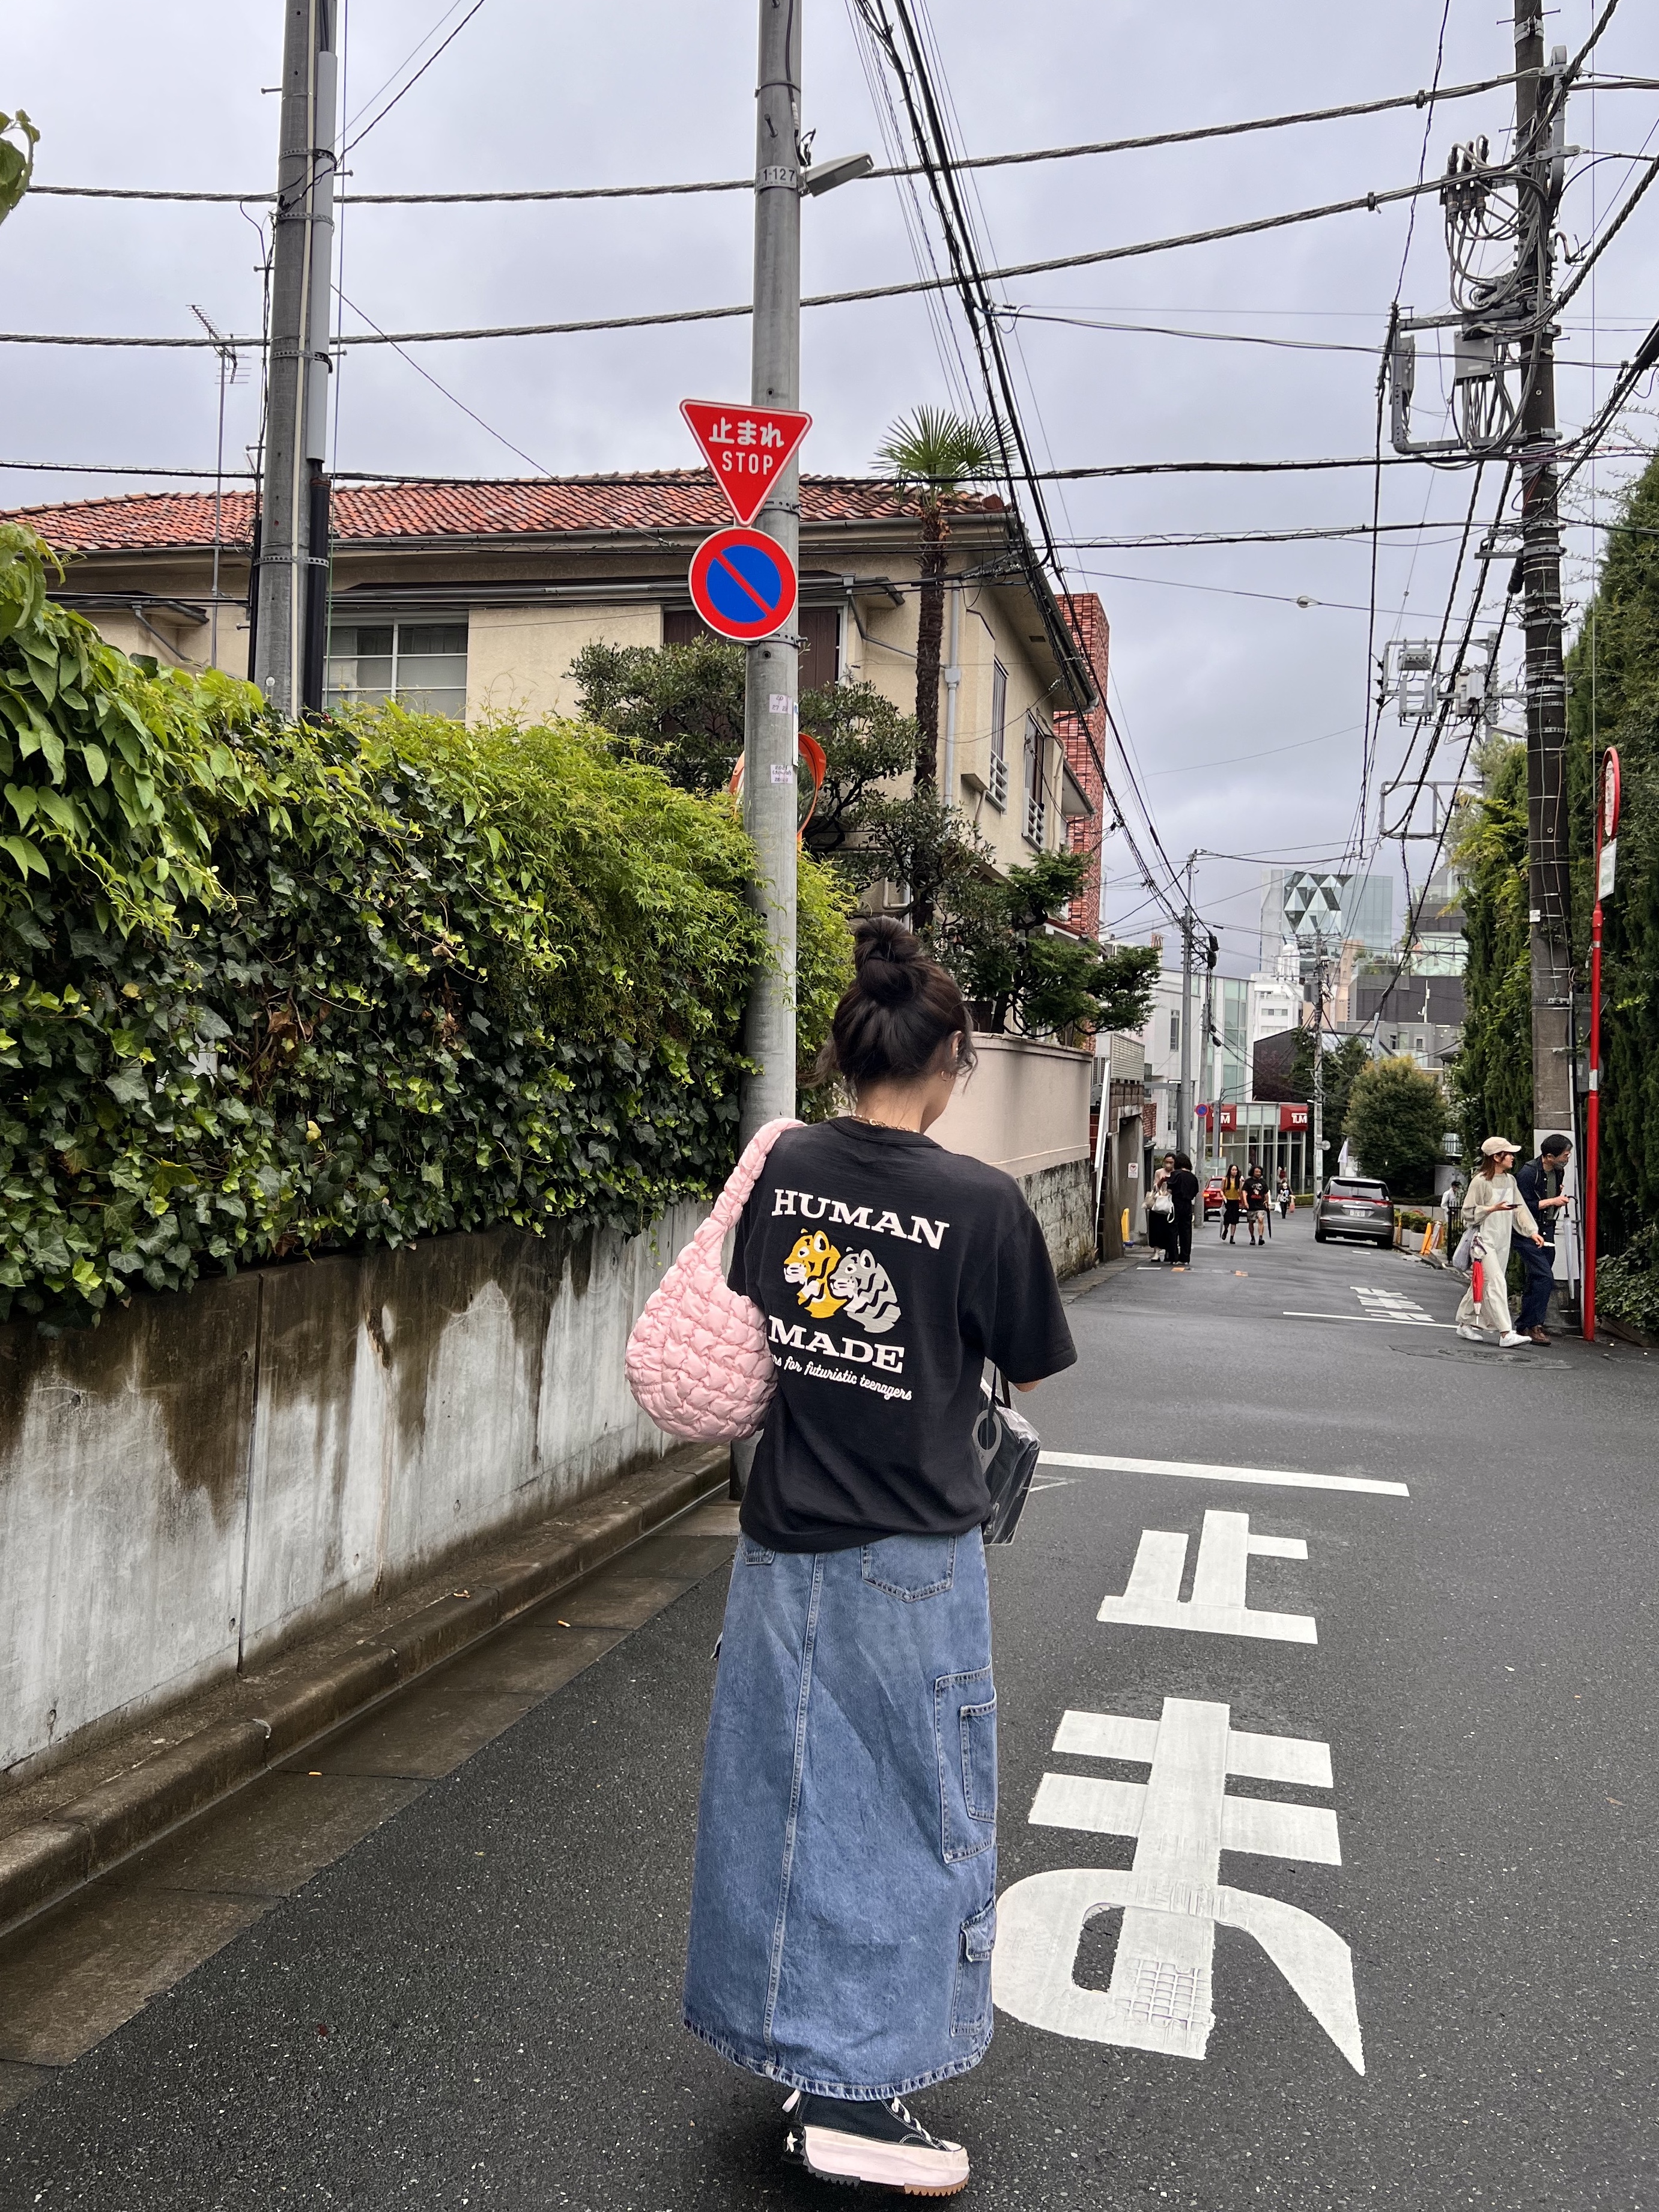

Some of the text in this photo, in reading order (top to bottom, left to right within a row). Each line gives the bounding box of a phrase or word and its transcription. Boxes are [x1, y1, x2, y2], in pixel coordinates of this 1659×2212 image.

[763, 168, 795, 182] 1-127
[708, 417, 784, 448] 止まれ
[722, 450, 774, 475] STOP
[771, 1189, 950, 1250] HUMAN
[768, 1315, 905, 1374] MADE
[784, 1356, 802, 1372] for
[804, 1361, 858, 1384] futuristic
[859, 1374, 912, 1401] teenagers
